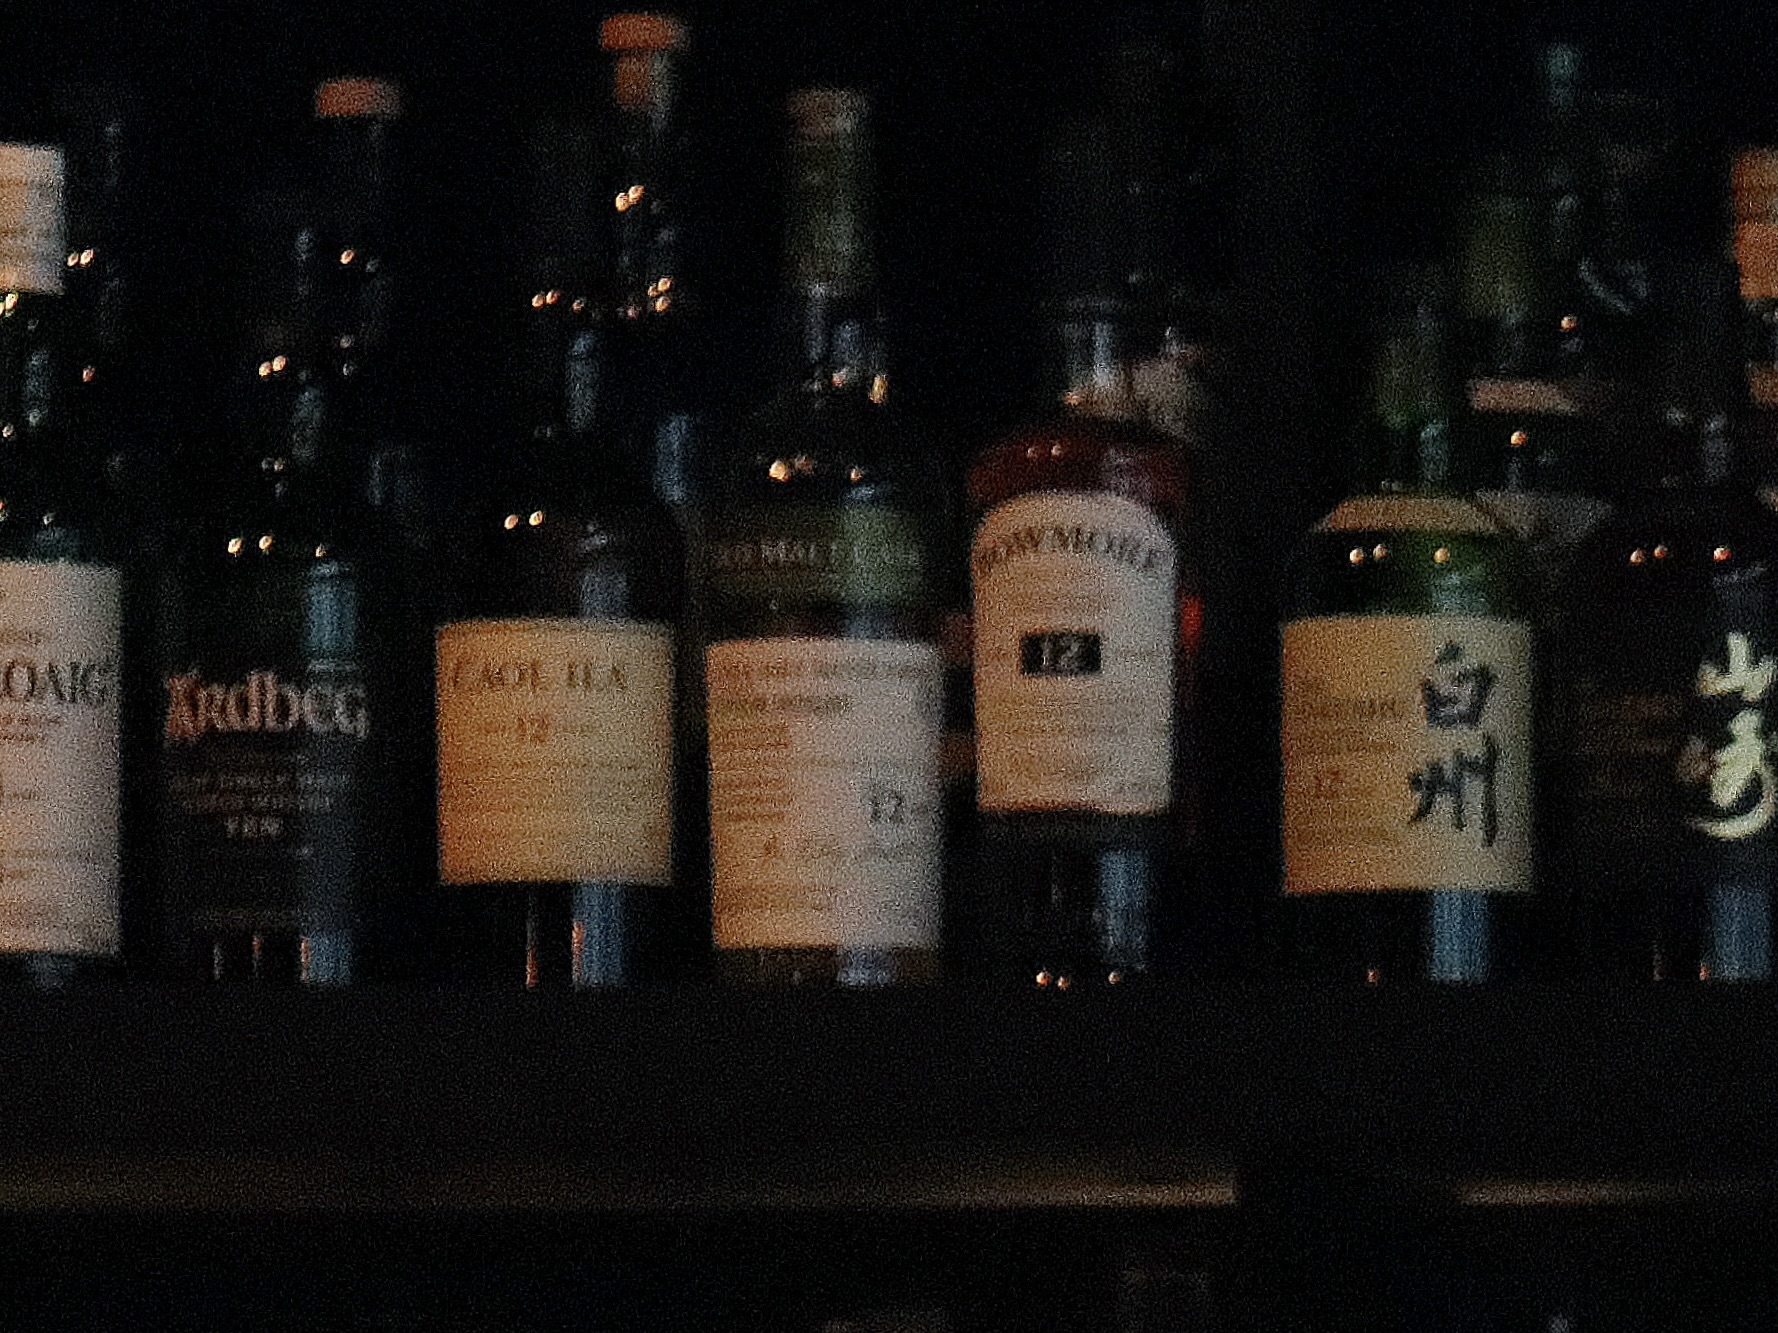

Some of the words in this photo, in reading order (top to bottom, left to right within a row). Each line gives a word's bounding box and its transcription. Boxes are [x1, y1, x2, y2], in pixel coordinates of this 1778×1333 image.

[1039, 639, 1085, 670] 12
[448, 657, 547, 693] CAOL
[163, 665, 370, 746] Ardbeg
[516, 715, 550, 745] 12
[1409, 640, 1497, 848] 白州
